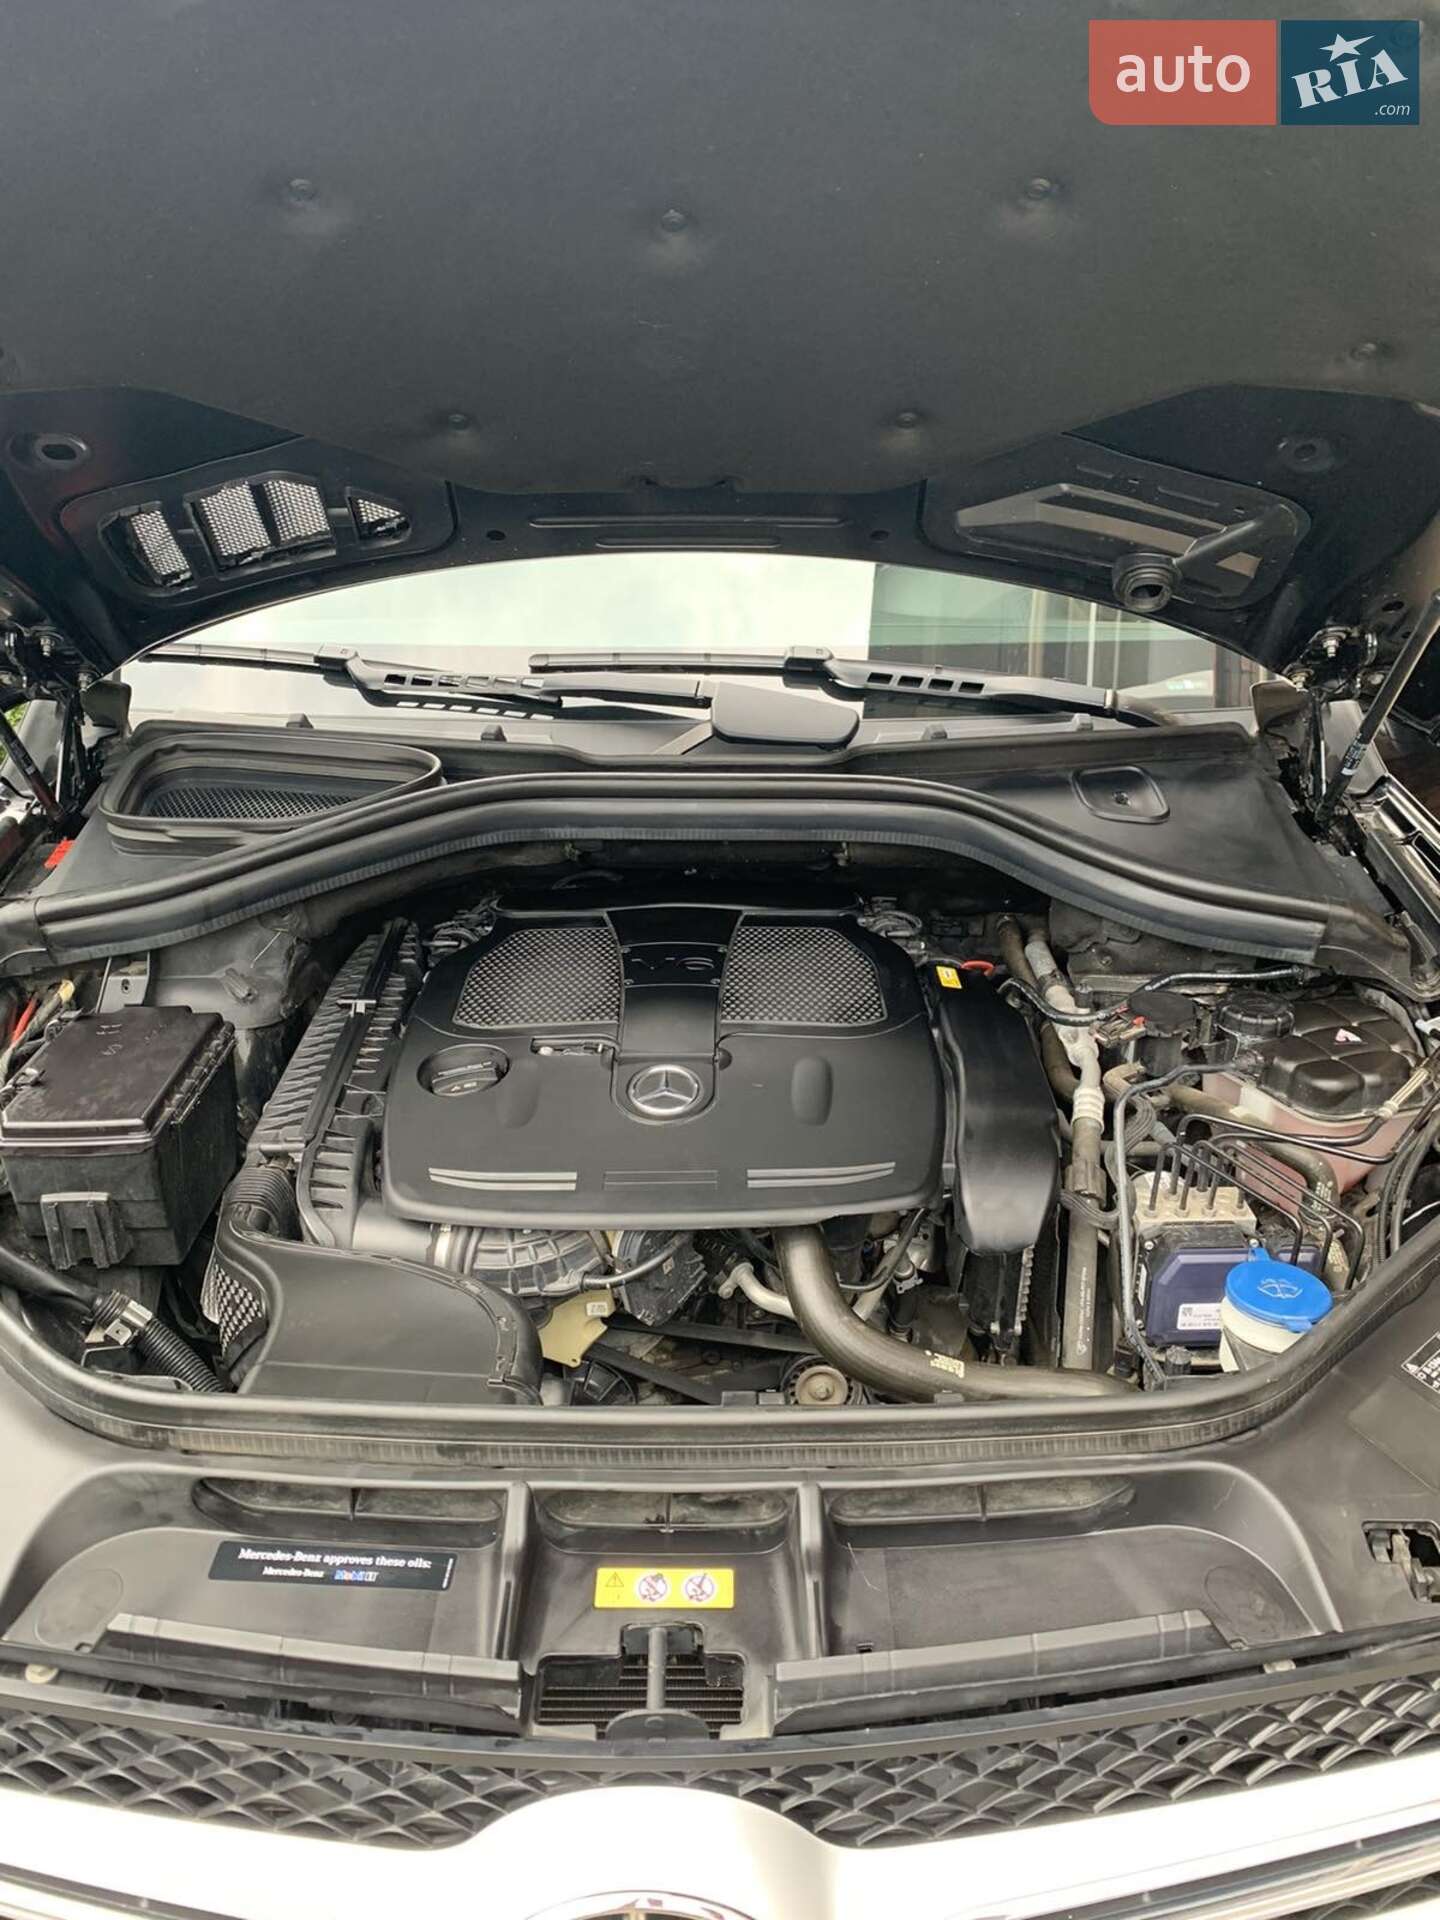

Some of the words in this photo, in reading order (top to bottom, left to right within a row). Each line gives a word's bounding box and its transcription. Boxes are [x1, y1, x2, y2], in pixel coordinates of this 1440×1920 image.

[238, 1548, 321, 1562] Mercedes-Benz
[323, 1554, 373, 1566] approves
[375, 1555, 406, 1568] these
